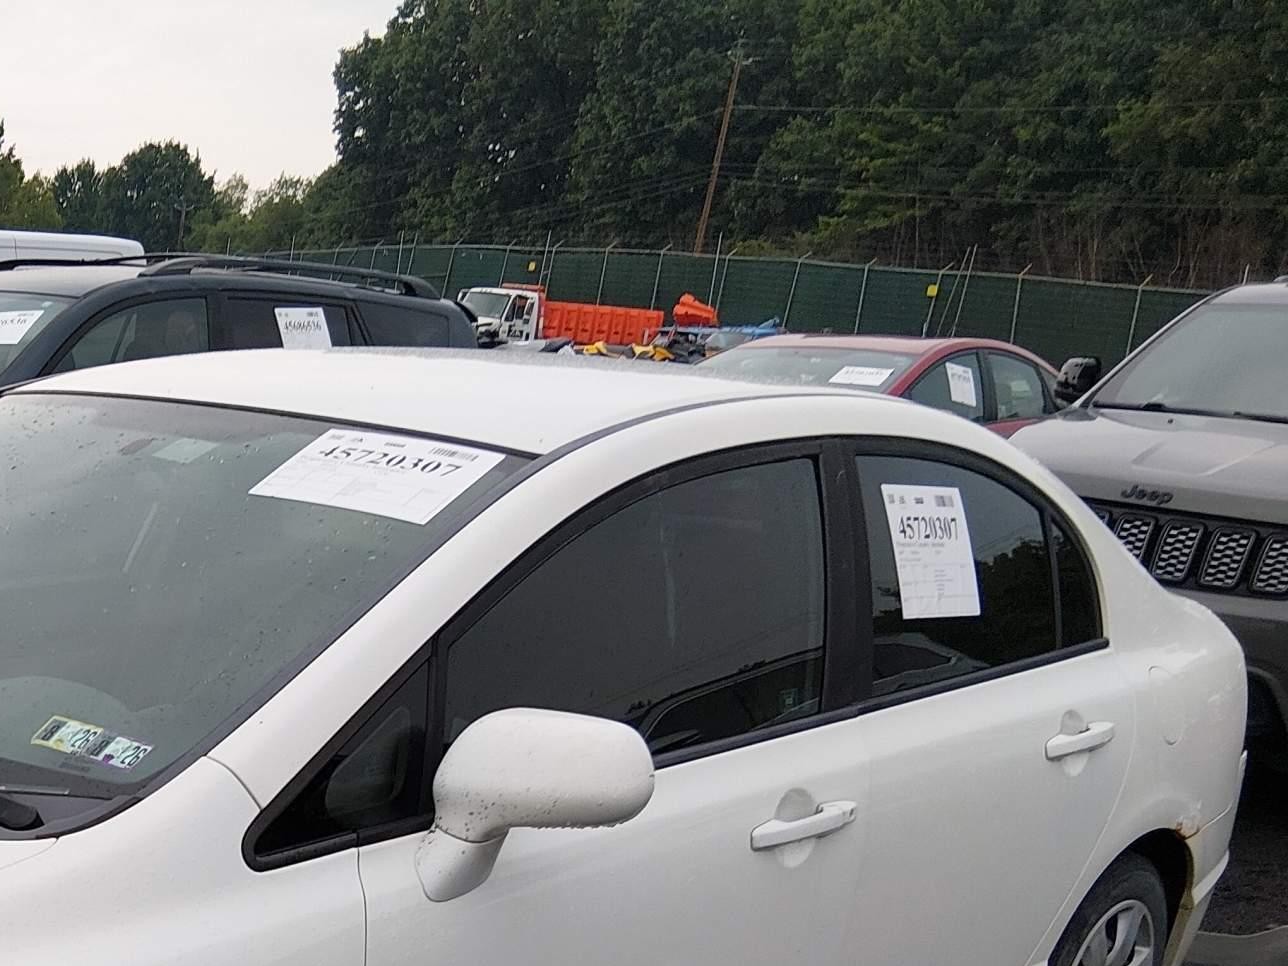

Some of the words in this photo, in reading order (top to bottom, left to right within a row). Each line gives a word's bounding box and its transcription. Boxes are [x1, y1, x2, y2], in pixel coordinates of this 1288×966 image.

[318, 444, 462, 478] 45720307
[1120, 484, 1174, 505] Jeep
[898, 516, 959, 541] 45720307
